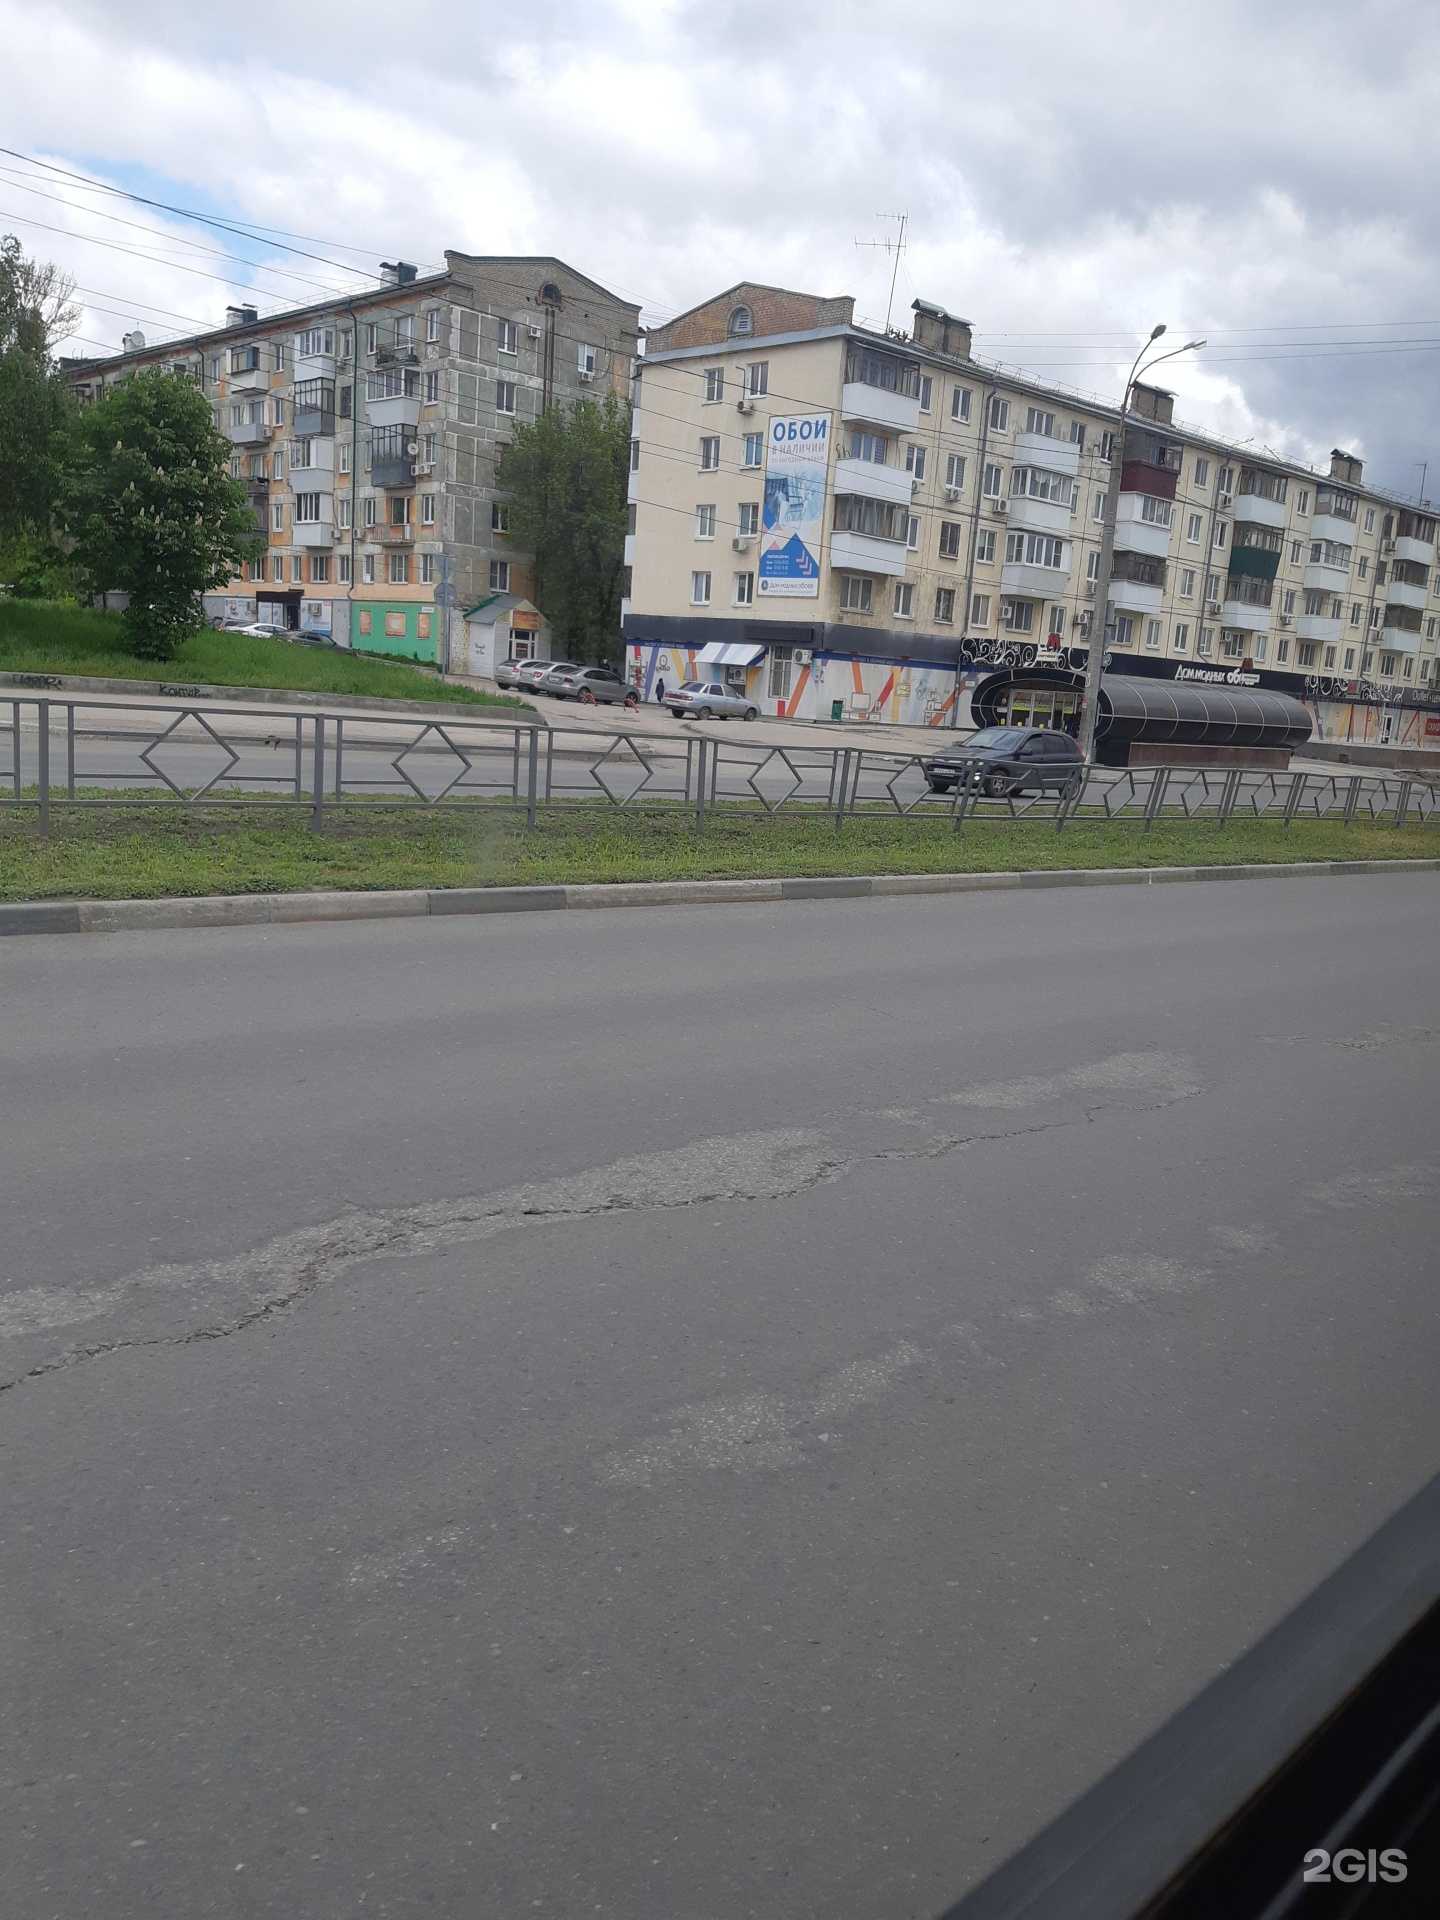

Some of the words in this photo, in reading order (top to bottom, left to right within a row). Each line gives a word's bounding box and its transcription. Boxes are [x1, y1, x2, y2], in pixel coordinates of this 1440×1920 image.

[773, 419, 827, 442] ОБОИ
[1174, 664, 1195, 681] Дом
[1195, 668, 1225, 684] модных
